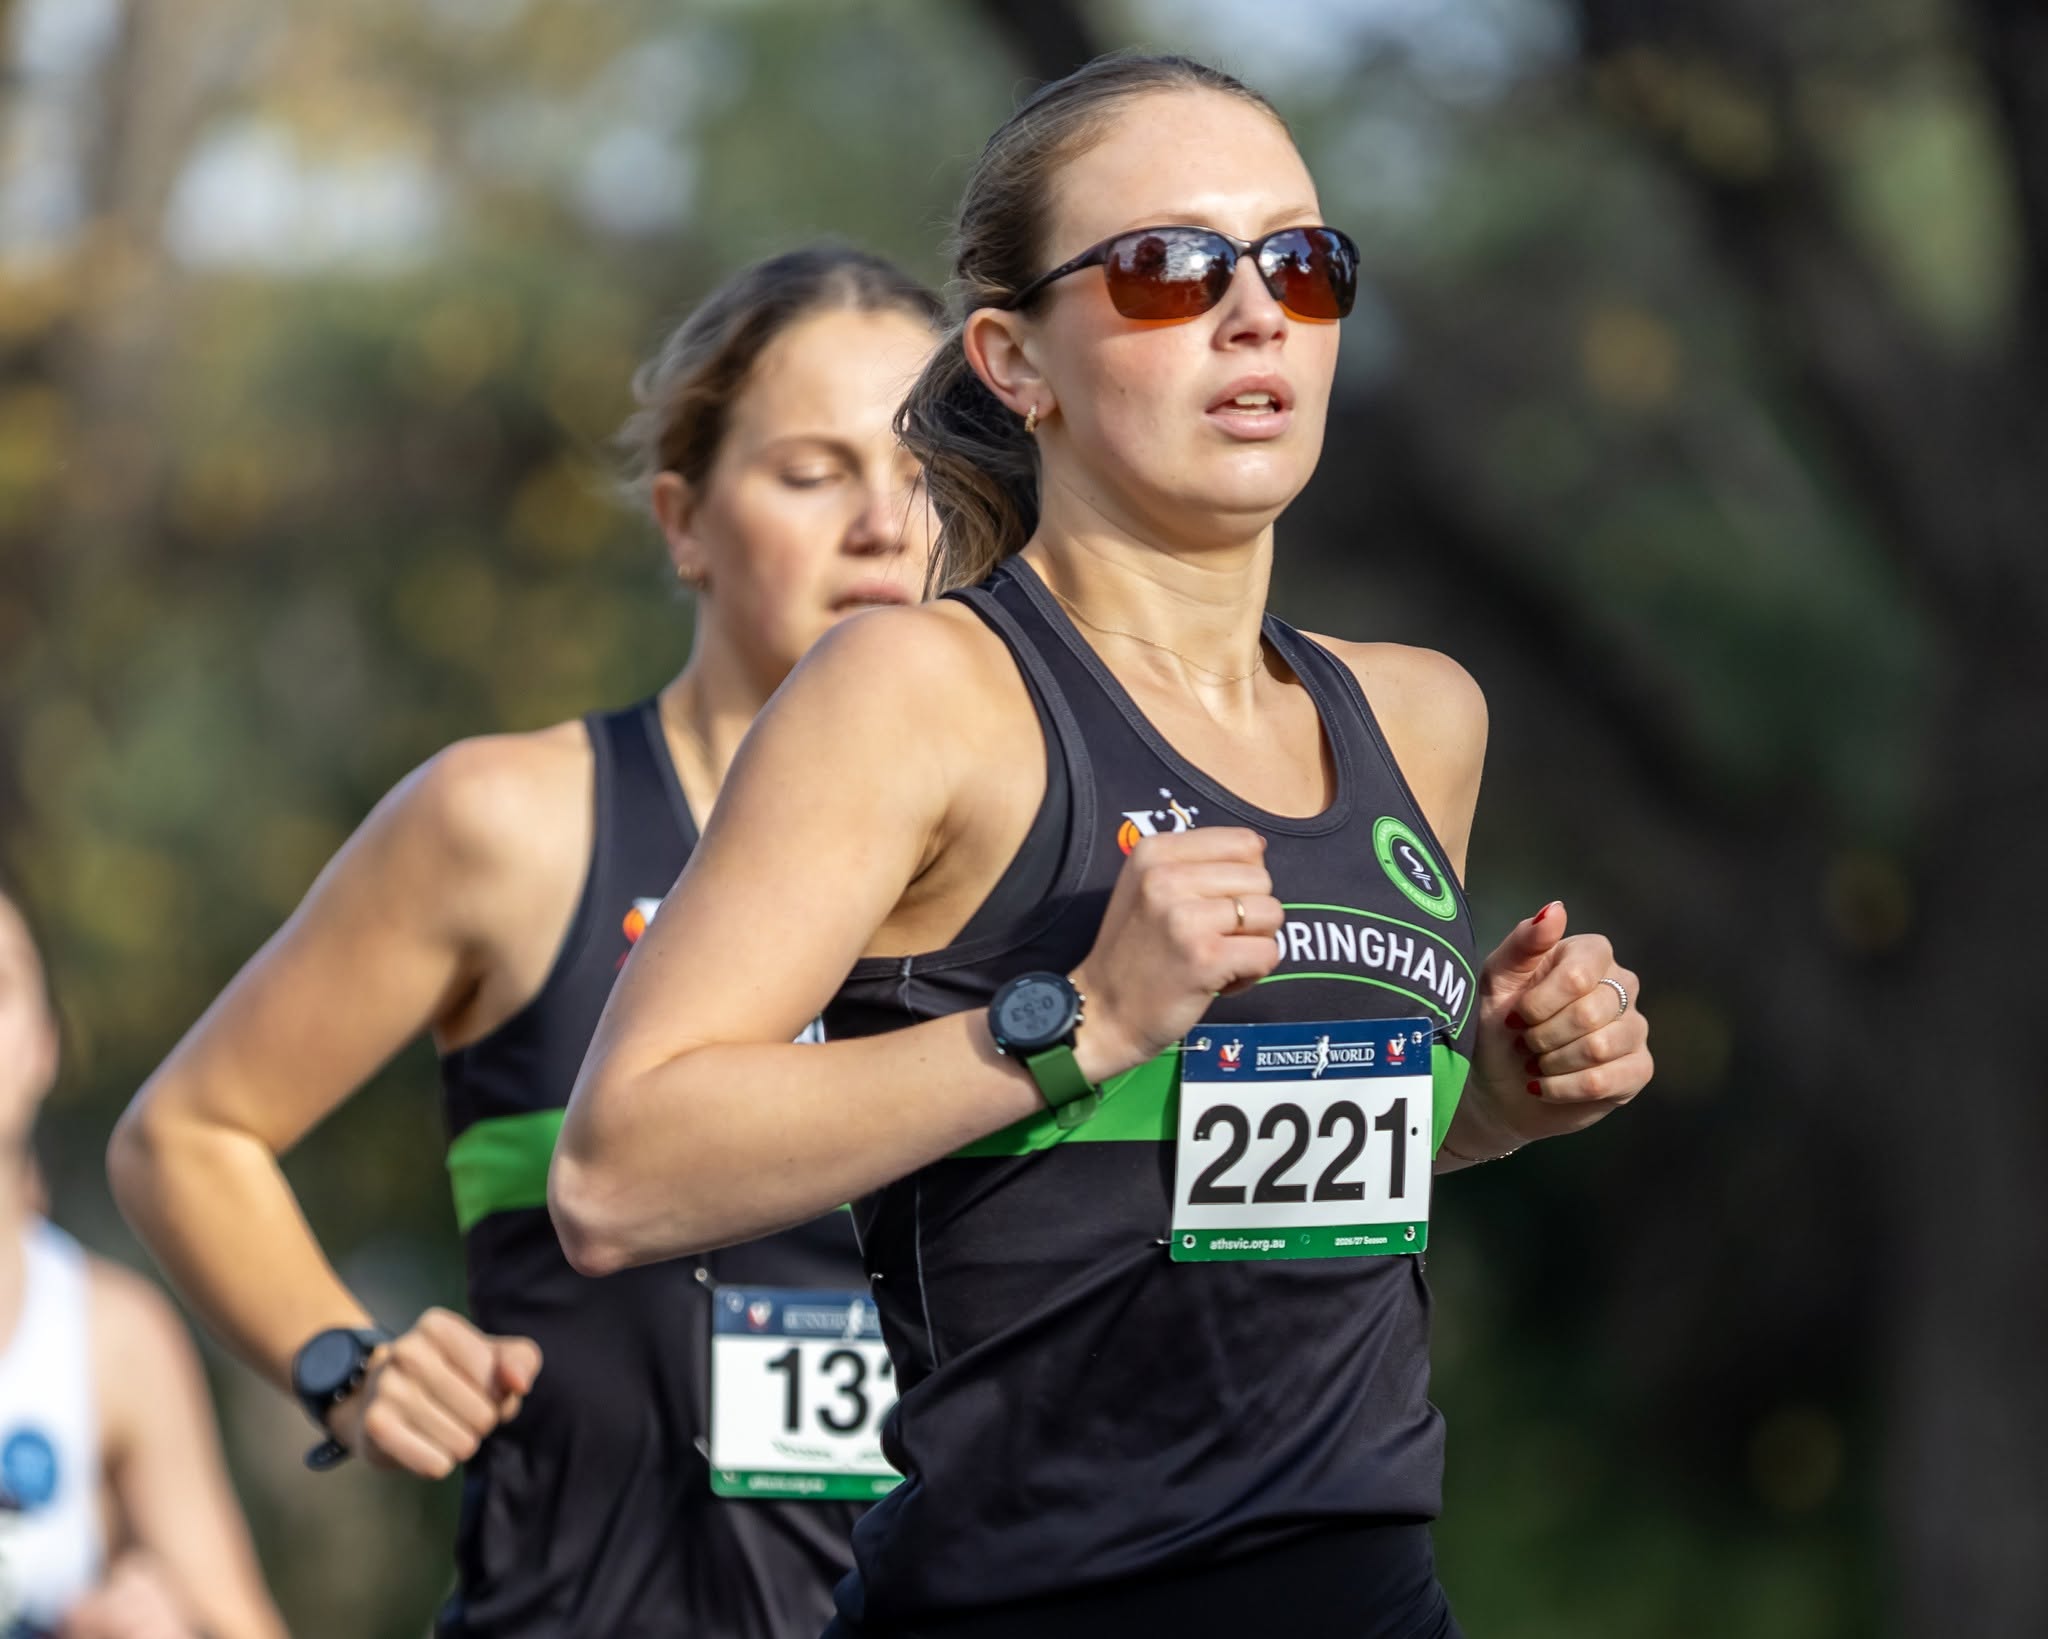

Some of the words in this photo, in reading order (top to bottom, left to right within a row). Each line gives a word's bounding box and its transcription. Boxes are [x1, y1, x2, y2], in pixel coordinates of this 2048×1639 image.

[1256, 1050, 1319, 1066] RUNNERS
[1329, 1048, 1375, 1062] WORLD
[1187, 1097, 1408, 1206] 2221
[1210, 1238, 1286, 1252] athsvic.org.au
